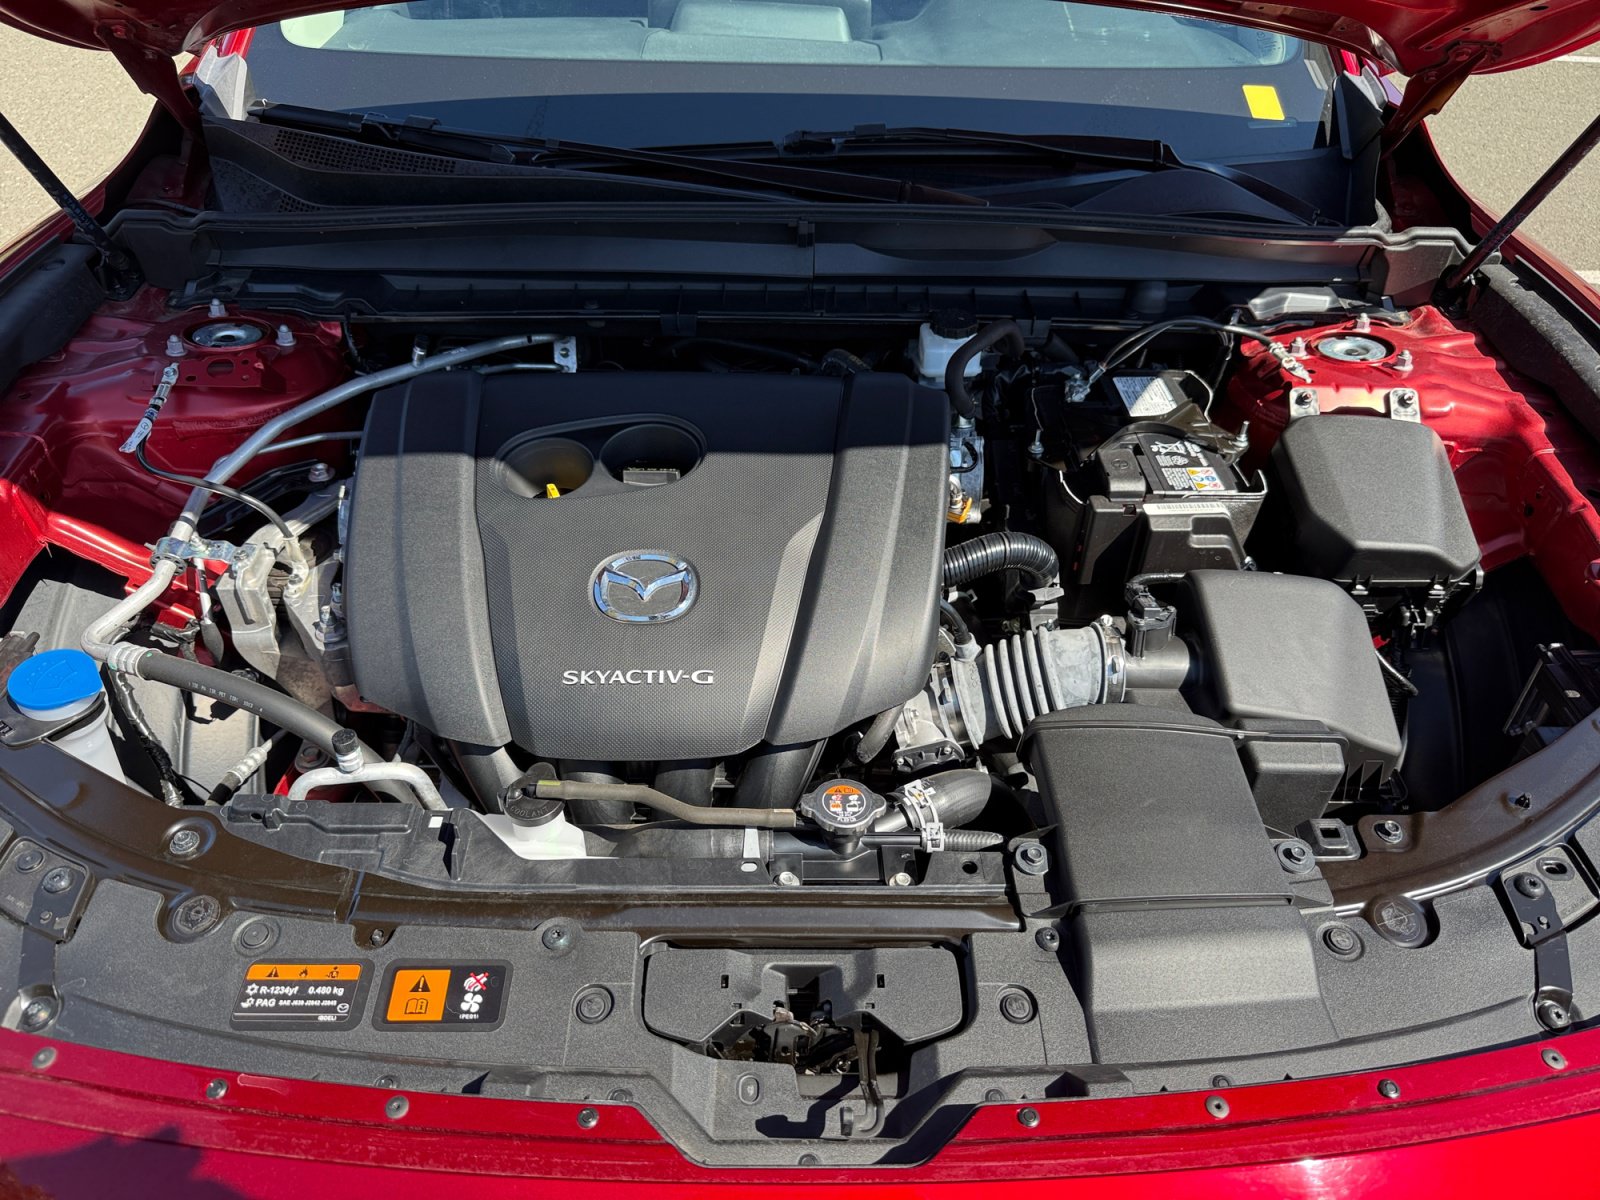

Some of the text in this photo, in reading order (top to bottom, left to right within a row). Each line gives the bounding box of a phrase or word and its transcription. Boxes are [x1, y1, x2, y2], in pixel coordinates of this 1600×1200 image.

[562, 669, 715, 685] SKYACTIV-G
[510, 805, 549, 817] COOLANT
[259, 986, 344, 996] R-1234yf 0.480 kg
[255, 998, 276, 1007] PAG
